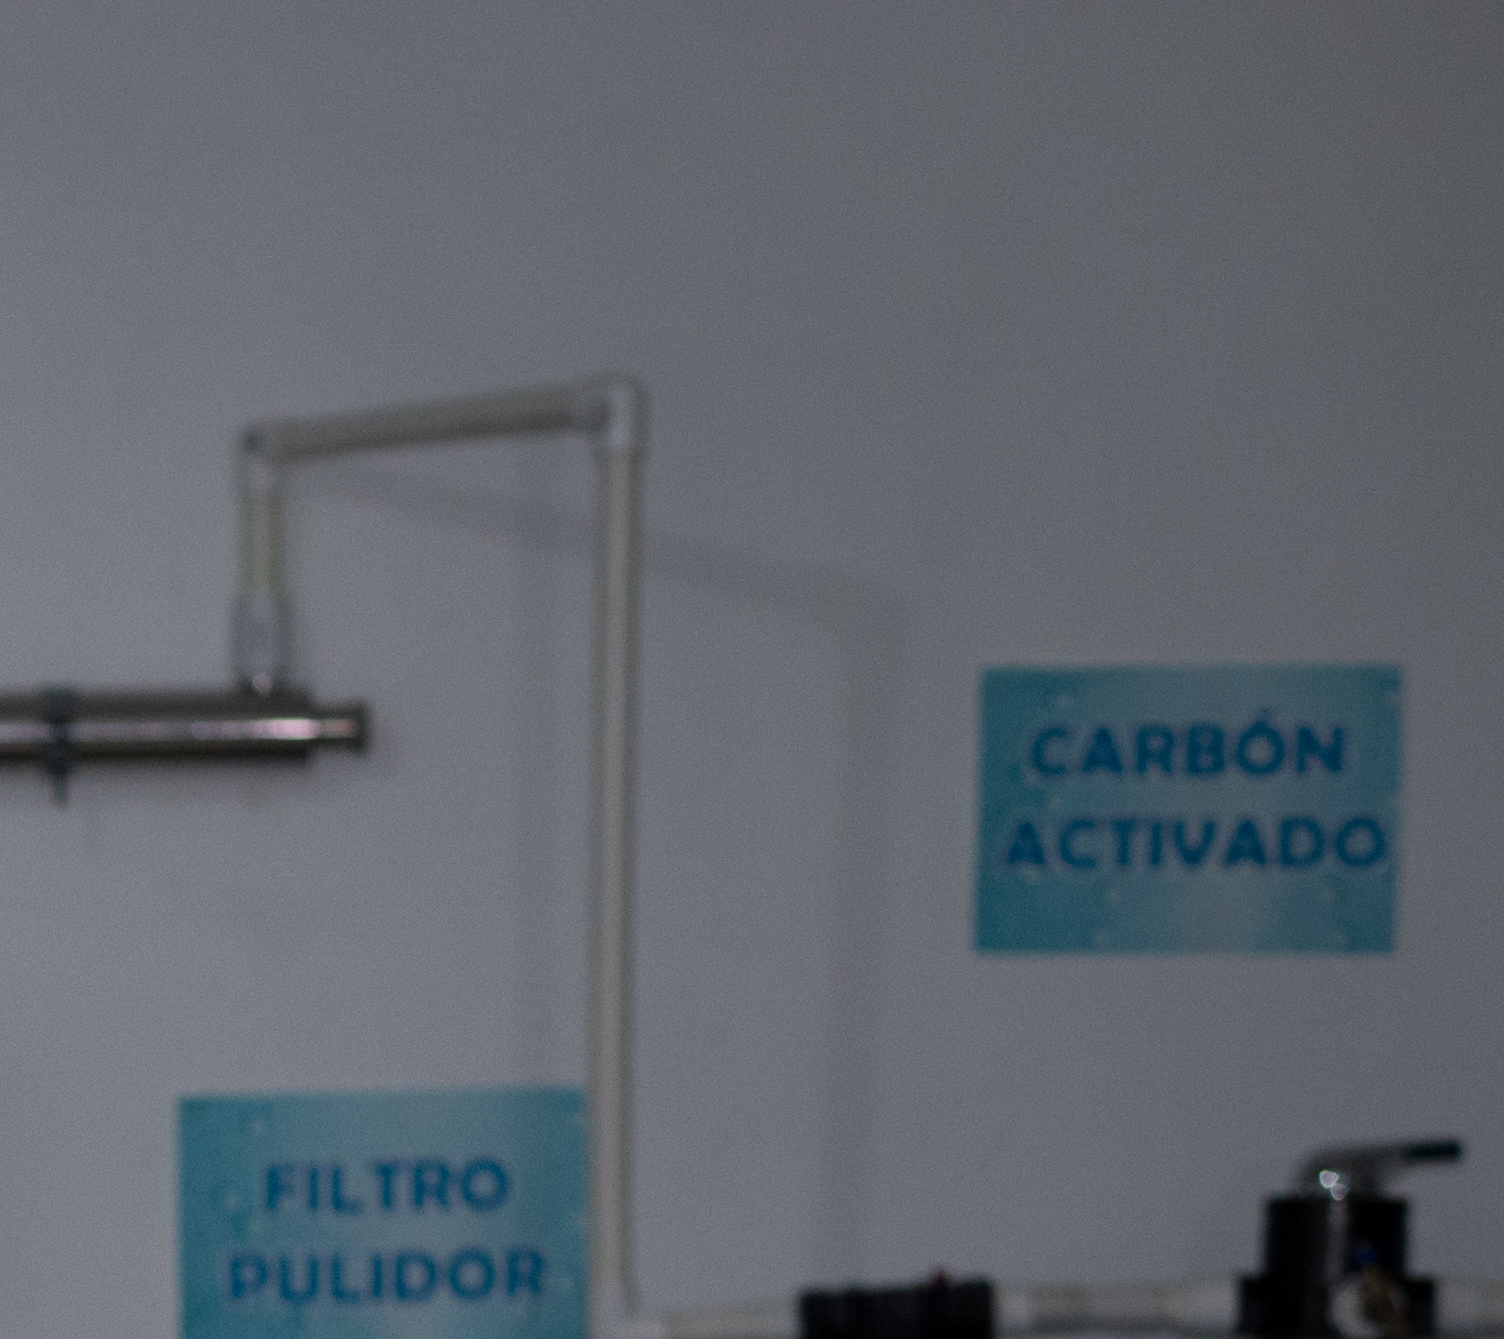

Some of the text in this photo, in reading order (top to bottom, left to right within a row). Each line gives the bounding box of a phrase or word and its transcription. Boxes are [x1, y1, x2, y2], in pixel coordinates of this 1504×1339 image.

[1031, 709, 1345, 776] CARBÓN
[1006, 816, 1386, 868] ACTIVADO
[266, 1157, 510, 1214] FILTRO
[229, 1247, 545, 1303] PULIDOR
